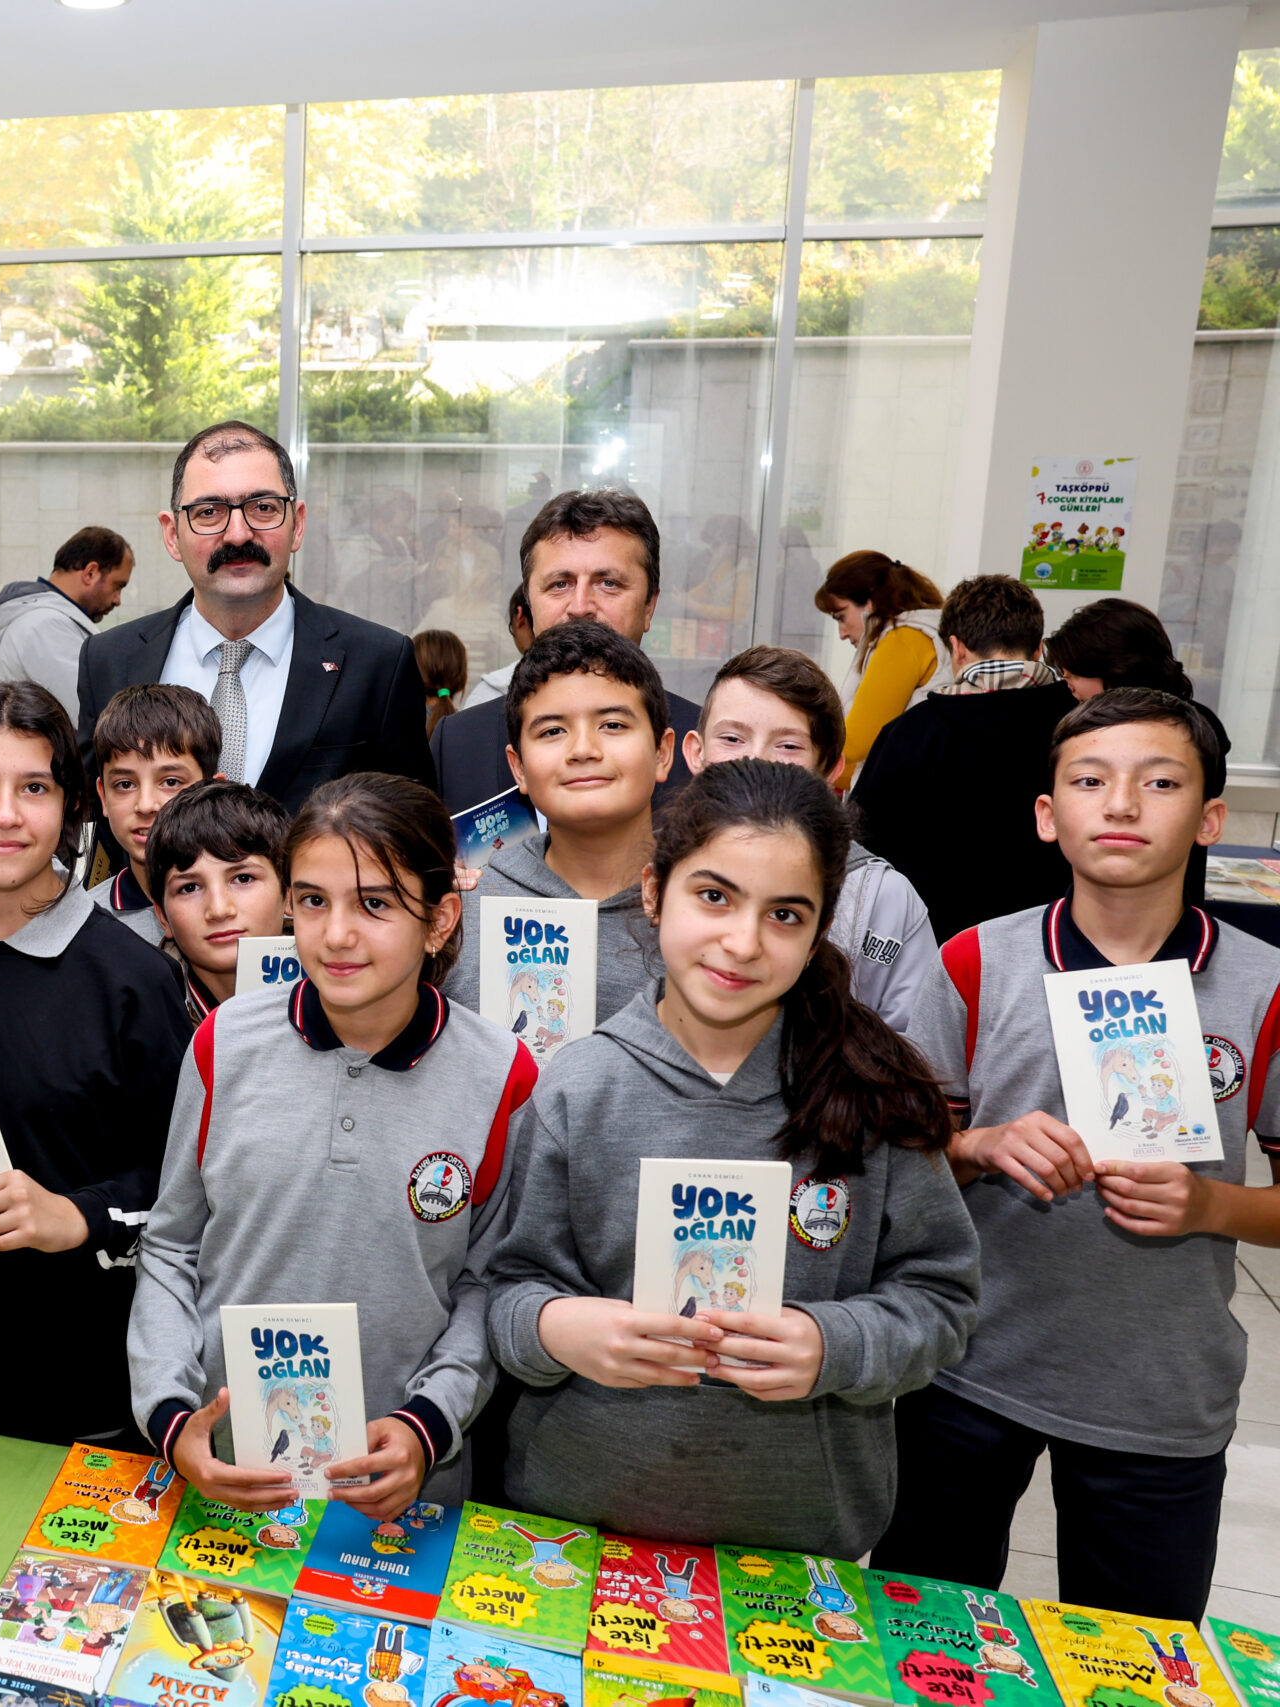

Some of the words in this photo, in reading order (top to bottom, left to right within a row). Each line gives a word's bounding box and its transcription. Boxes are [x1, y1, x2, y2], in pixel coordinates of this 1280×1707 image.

[1056, 482, 1110, 493] TAŞKÖPRÜ
[1048, 496, 1076, 504] ÇOCUK
[1060, 504, 1100, 512] GÜNLERİ
[475, 809, 508, 834] YOK
[481, 818, 510, 843] OĞLAN
[504, 916, 569, 946] YOK
[507, 944, 569, 966] OĞLAN
[1078, 989, 1163, 1023] YOK
[1089, 1012, 1166, 1043] OĞLAN
[1213, 1038, 1243, 1074] ORTAOKULU
[447, 1155, 471, 1194] ORTAOKULU
[672, 1183, 756, 1220] YOK
[674, 1217, 756, 1241] OĞLAN
[251, 1327, 329, 1360] YOK
[258, 1358, 330, 1380] OĞLAN
[64, 1480, 131, 1497] Öğretmen
[75, 1490, 111, 1503] Yeni
[49, 1516, 109, 1532] Mert!
[206, 1512, 254, 1527] Çılgın
[184, 1537, 248, 1556] Mert!
[464, 1543, 516, 1559] Yıldızı
[373, 1560, 410, 1576] TUHAF
[462, 1551, 516, 1567] Haftanın
[598, 1570, 652, 1585] Akşa
[606, 1581, 630, 1589] Bir
[459, 1585, 525, 1603] Mert!
[731, 1589, 807, 1605] Kuzenler
[745, 1600, 803, 1618] Çılgın
[591, 1615, 656, 1630] Mert!
[886, 1618, 972, 1641] Hediyesi
[744, 1636, 815, 1653] Mert!
[285, 1660, 360, 1684] Arkadaş
[286, 1650, 363, 1674] Ziyareti
[1065, 1652, 1156, 1675] Macerası
[903, 1663, 976, 1684] Mert!
[1079, 1664, 1152, 1685] Midilli
[11, 1680, 36, 1692] SUSIE
[149, 1673, 230, 1702] ADAM
